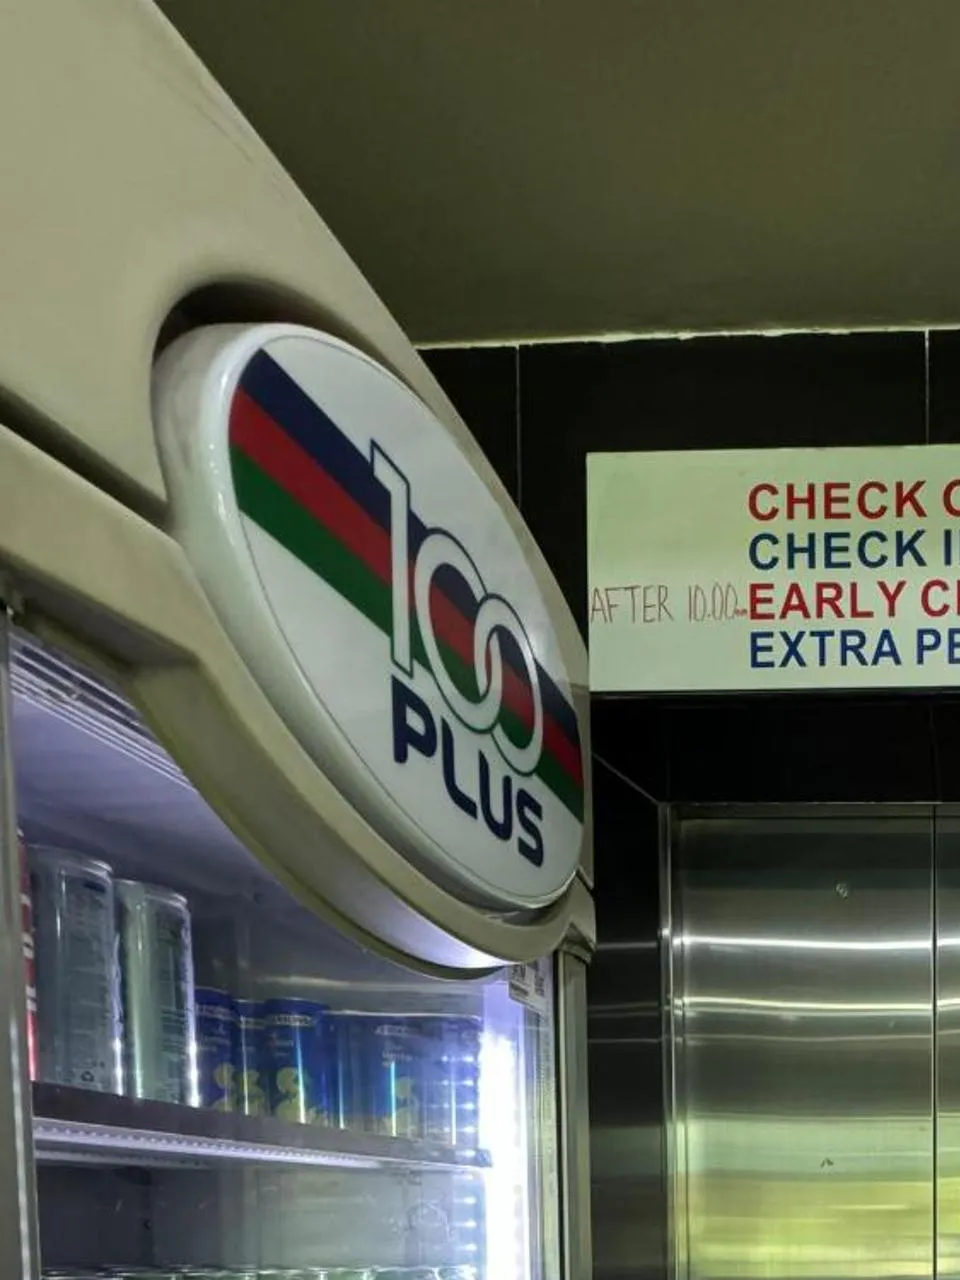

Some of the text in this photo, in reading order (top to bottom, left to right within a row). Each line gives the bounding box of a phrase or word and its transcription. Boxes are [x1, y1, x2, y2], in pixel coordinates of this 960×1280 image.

[748, 480, 928, 521] CHECK
[748, 530, 927, 571] CHECK
[591, 582, 675, 624] AFTER
[748, 579, 908, 621] EARLY
[750, 629, 902, 669] EXTRA
[391, 675, 544, 868] PLUS
